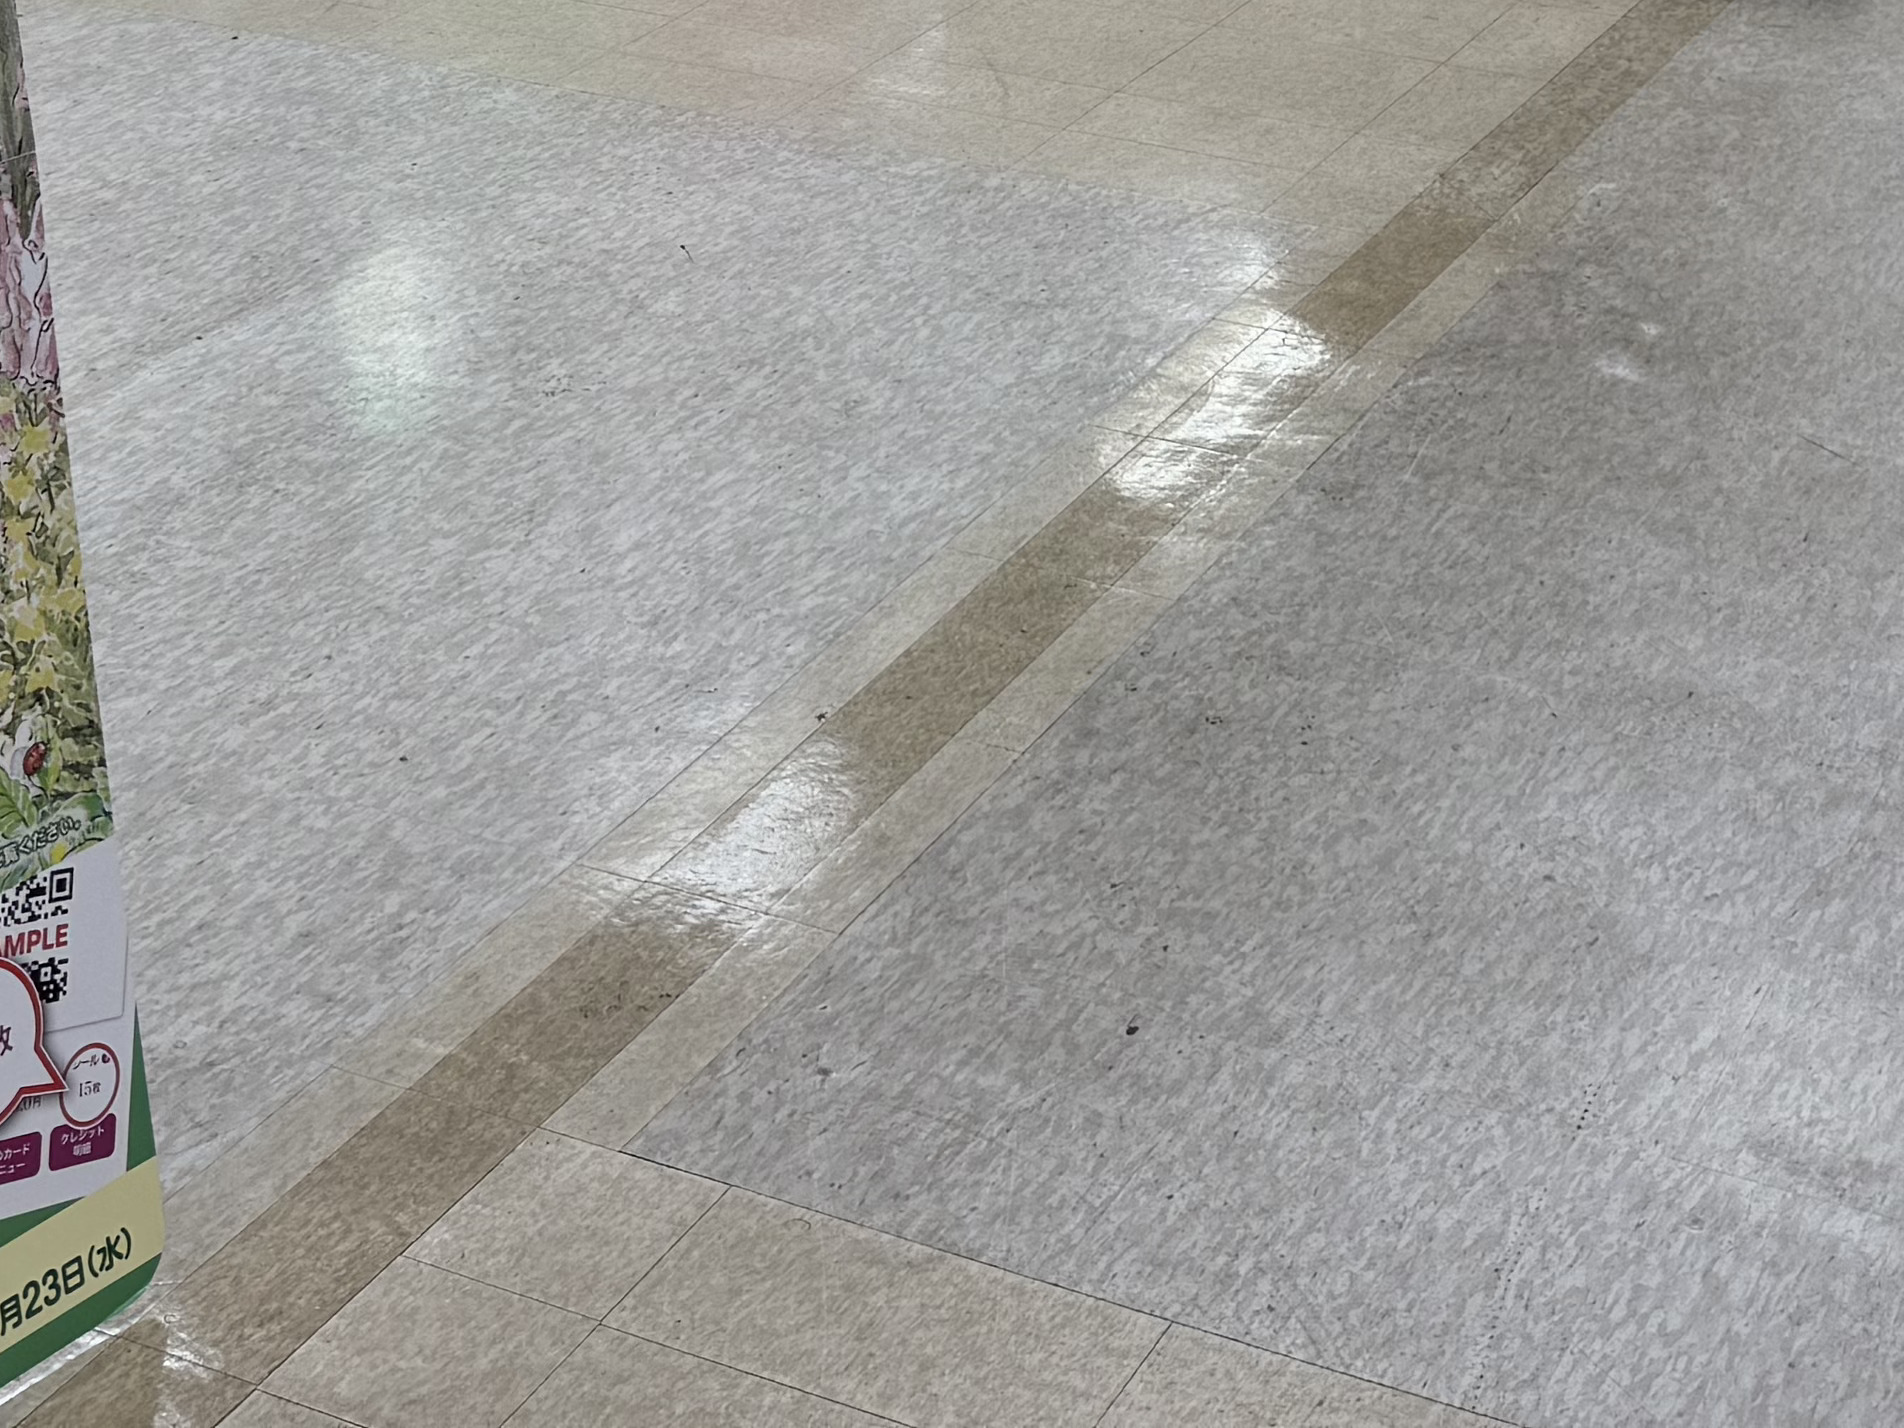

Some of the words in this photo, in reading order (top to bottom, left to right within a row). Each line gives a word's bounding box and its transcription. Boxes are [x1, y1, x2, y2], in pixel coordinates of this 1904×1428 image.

[59, 1124, 106, 1147] クレジット
